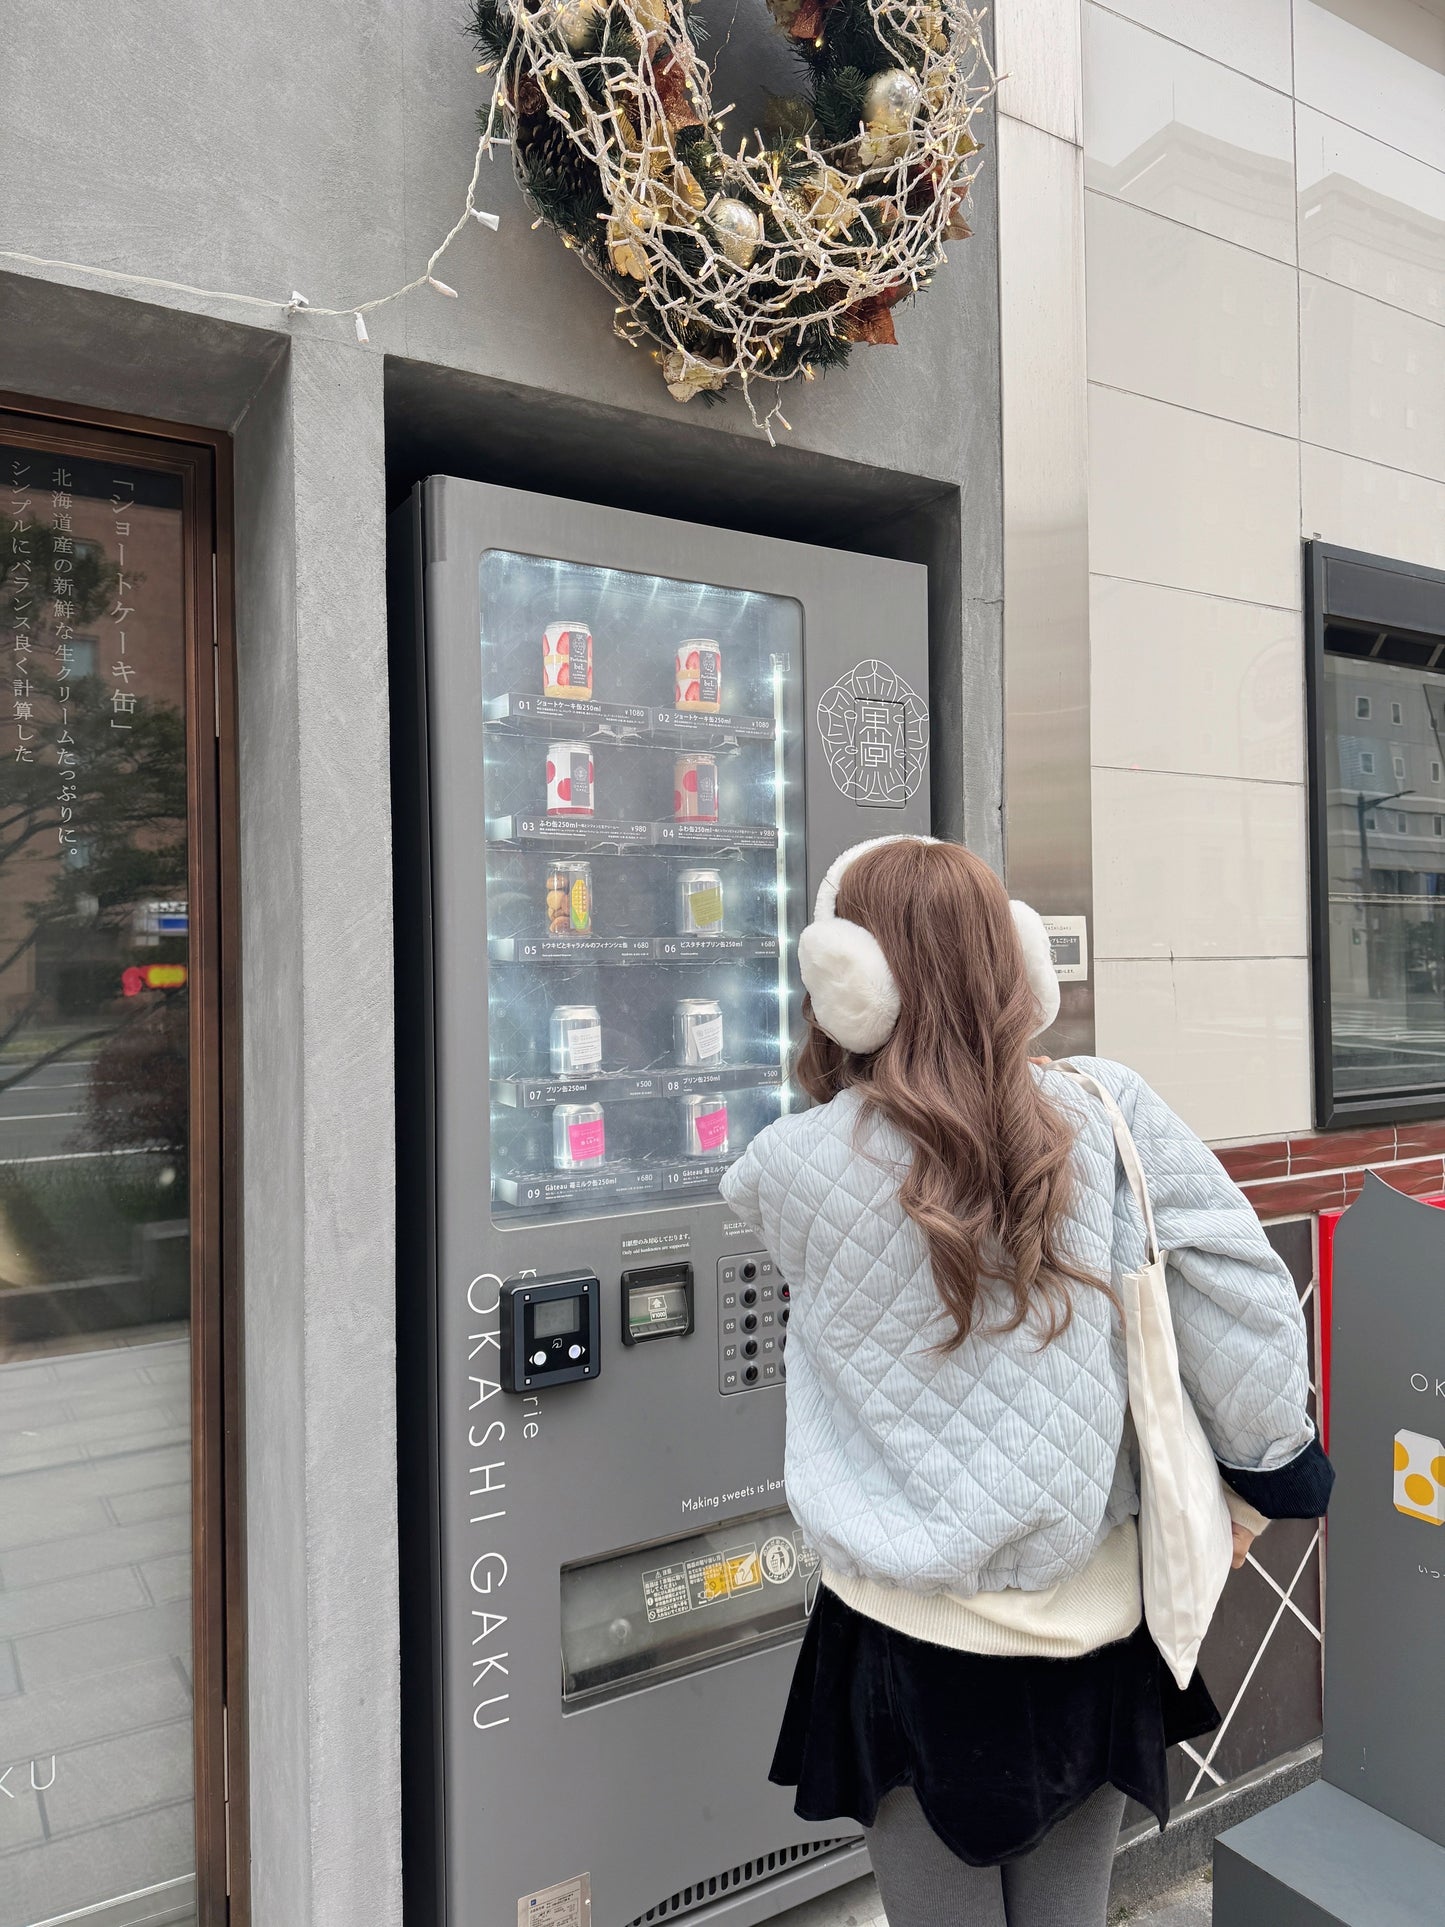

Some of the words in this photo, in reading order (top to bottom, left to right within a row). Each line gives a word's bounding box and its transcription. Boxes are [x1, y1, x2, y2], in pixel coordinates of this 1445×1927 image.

[10, 460, 34, 763] シンプルにバランス良く計算した
[110, 478, 138, 730] 「ショートケーキ缶」
[52, 467, 78, 855] 北海道産の新鮮な生クリームたっぷりに。
[518, 700, 531, 710] 01
[624, 708, 645, 717] ¥1080
[658, 712, 670, 723] 02
[751, 720, 770, 729] ¥1080
[522, 821, 535, 832] 03
[631, 825, 647, 833] ¥980
[662, 829, 674, 838] 04
[524, 945, 537, 955] 05
[634, 941, 649, 949] ¥680
[664, 944, 676, 953] 06
[529, 1090, 541, 1100] 07
[636, 1080, 652, 1088] ¥500
[667, 1081, 679, 1091] 08
[763, 1070, 778, 1078] ¥500
[527, 1188, 540, 1199] 09
[636, 1174, 653, 1182] ¥680
[668, 1173, 679, 1183] 10
[726, 1348, 734, 1356] 07
[467, 1272, 506, 1523] OKASHI
[681, 1495, 719, 1513] Making
[721, 1485, 755, 1503] sweets
[757, 1484, 765, 1493] is
[1418, 1564, 1445, 1579] いつ
[470, 1552, 510, 1731] GAKU
[0, 1754, 55, 1799] KU
